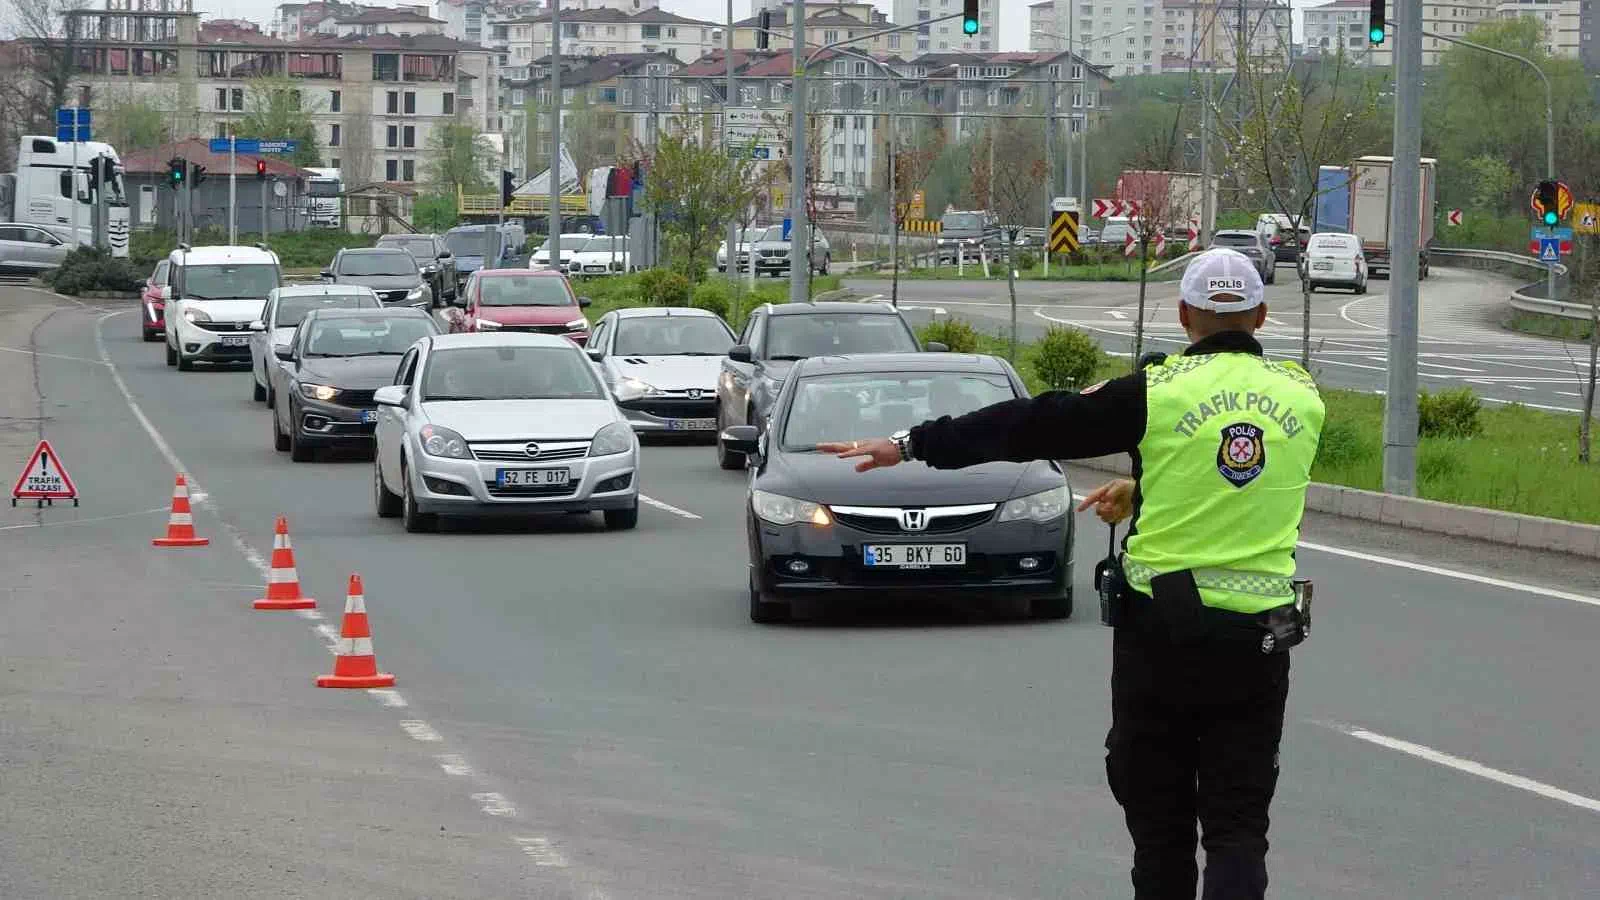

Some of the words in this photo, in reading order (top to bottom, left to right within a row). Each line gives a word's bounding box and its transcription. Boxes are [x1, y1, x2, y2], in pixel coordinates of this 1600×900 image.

[1210, 279, 1243, 289] POLİS
[1173, 389, 1243, 438] TRAFİK
[1246, 391, 1304, 439] POLİSİ
[1229, 425, 1256, 437] POLİS
[28, 475, 60, 484] TRAFİK
[505, 471, 518, 483] 52
[525, 471, 538, 483] FE
[547, 471, 566, 482] 017
[875, 547, 892, 562] 35
[906, 547, 933, 562] BKY
[944, 546, 962, 562] 60
